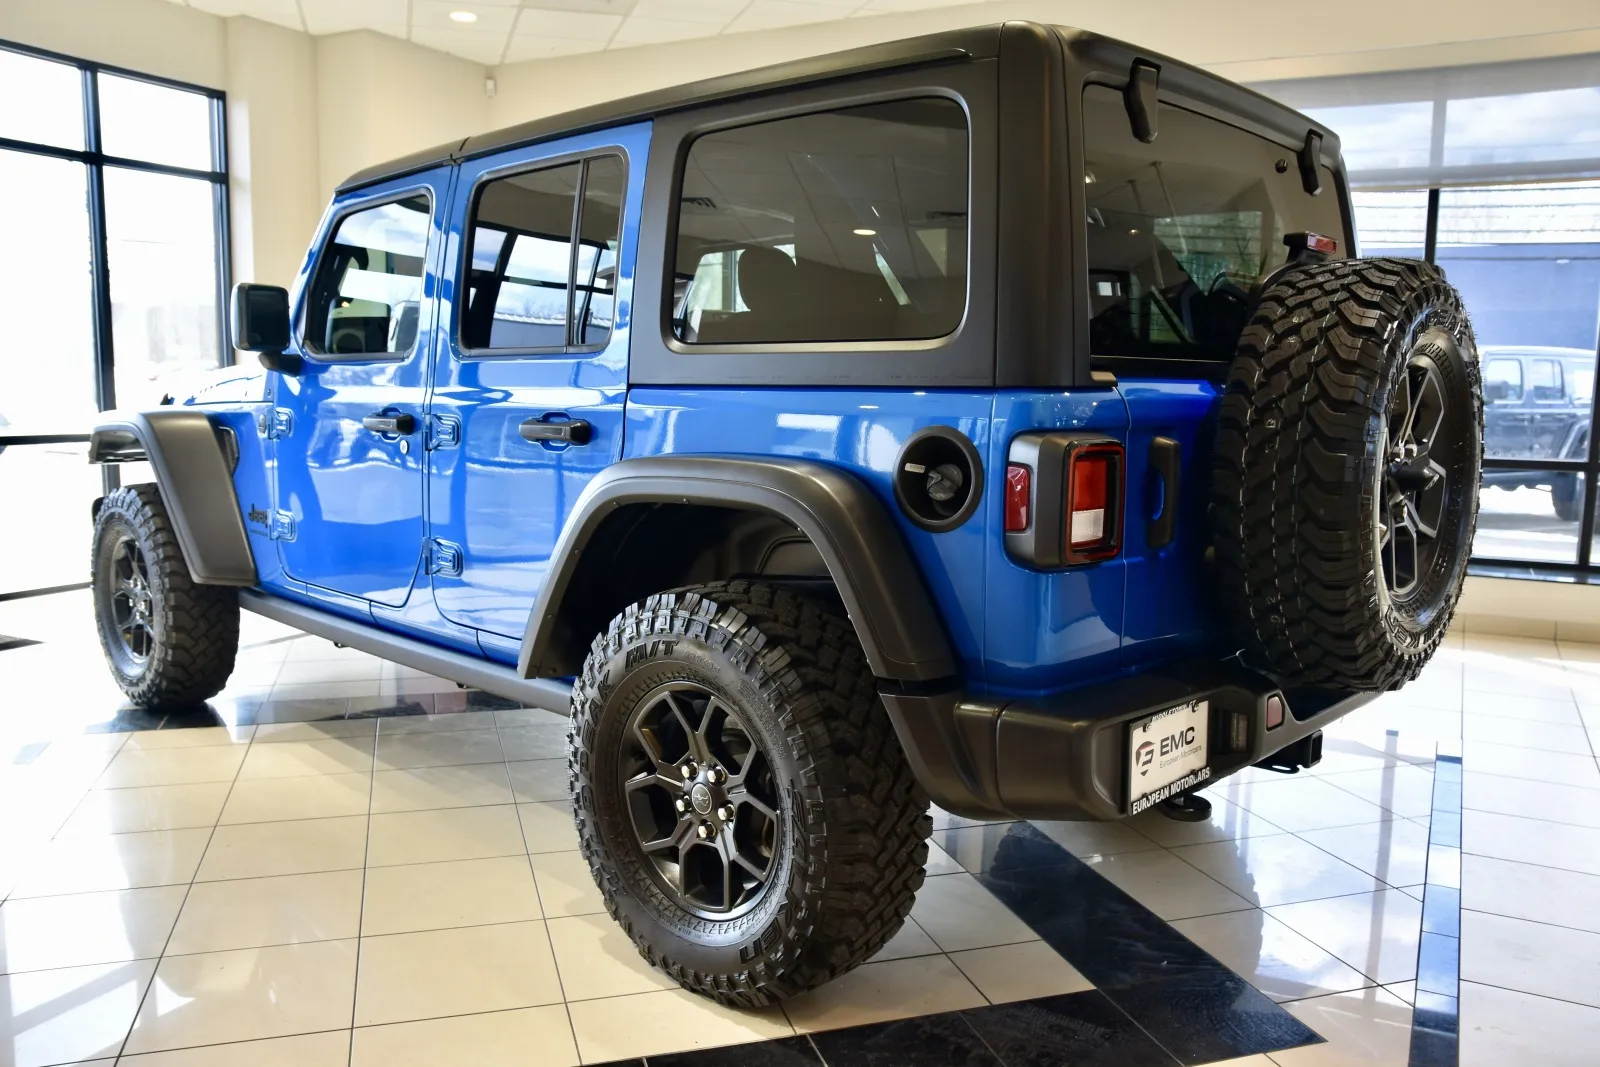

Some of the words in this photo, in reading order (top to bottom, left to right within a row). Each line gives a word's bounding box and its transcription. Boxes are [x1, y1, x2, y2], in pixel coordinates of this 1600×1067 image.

[625, 639, 680, 671] M/T
[1160, 726, 1195, 757] EMC
[1132, 785, 1170, 815] EUROPEAN
[1170, 766, 1210, 793] MOTORCARS
